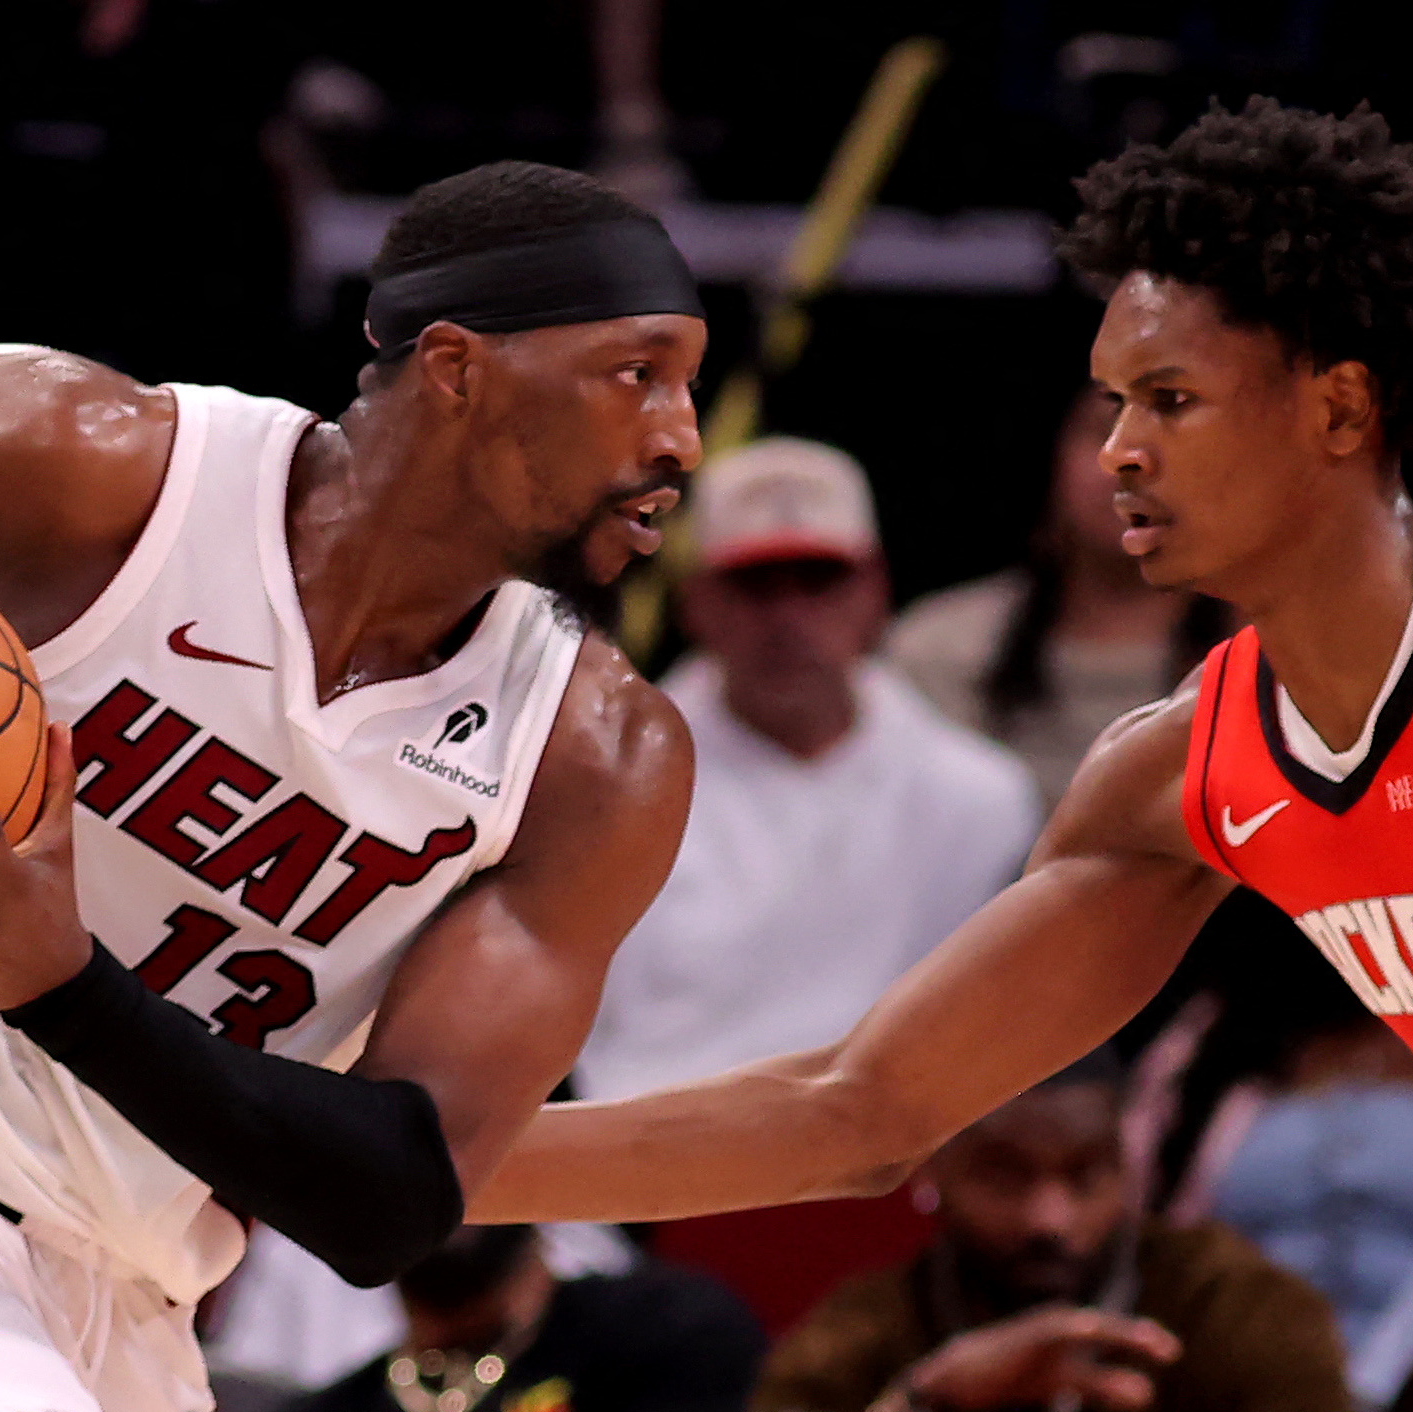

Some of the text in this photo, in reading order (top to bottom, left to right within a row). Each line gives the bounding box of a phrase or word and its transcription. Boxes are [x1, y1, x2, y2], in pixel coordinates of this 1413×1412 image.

[71, 678, 477, 948] HEAT
[399, 743, 500, 798] Robinhood
[128, 904, 318, 1054] 13
